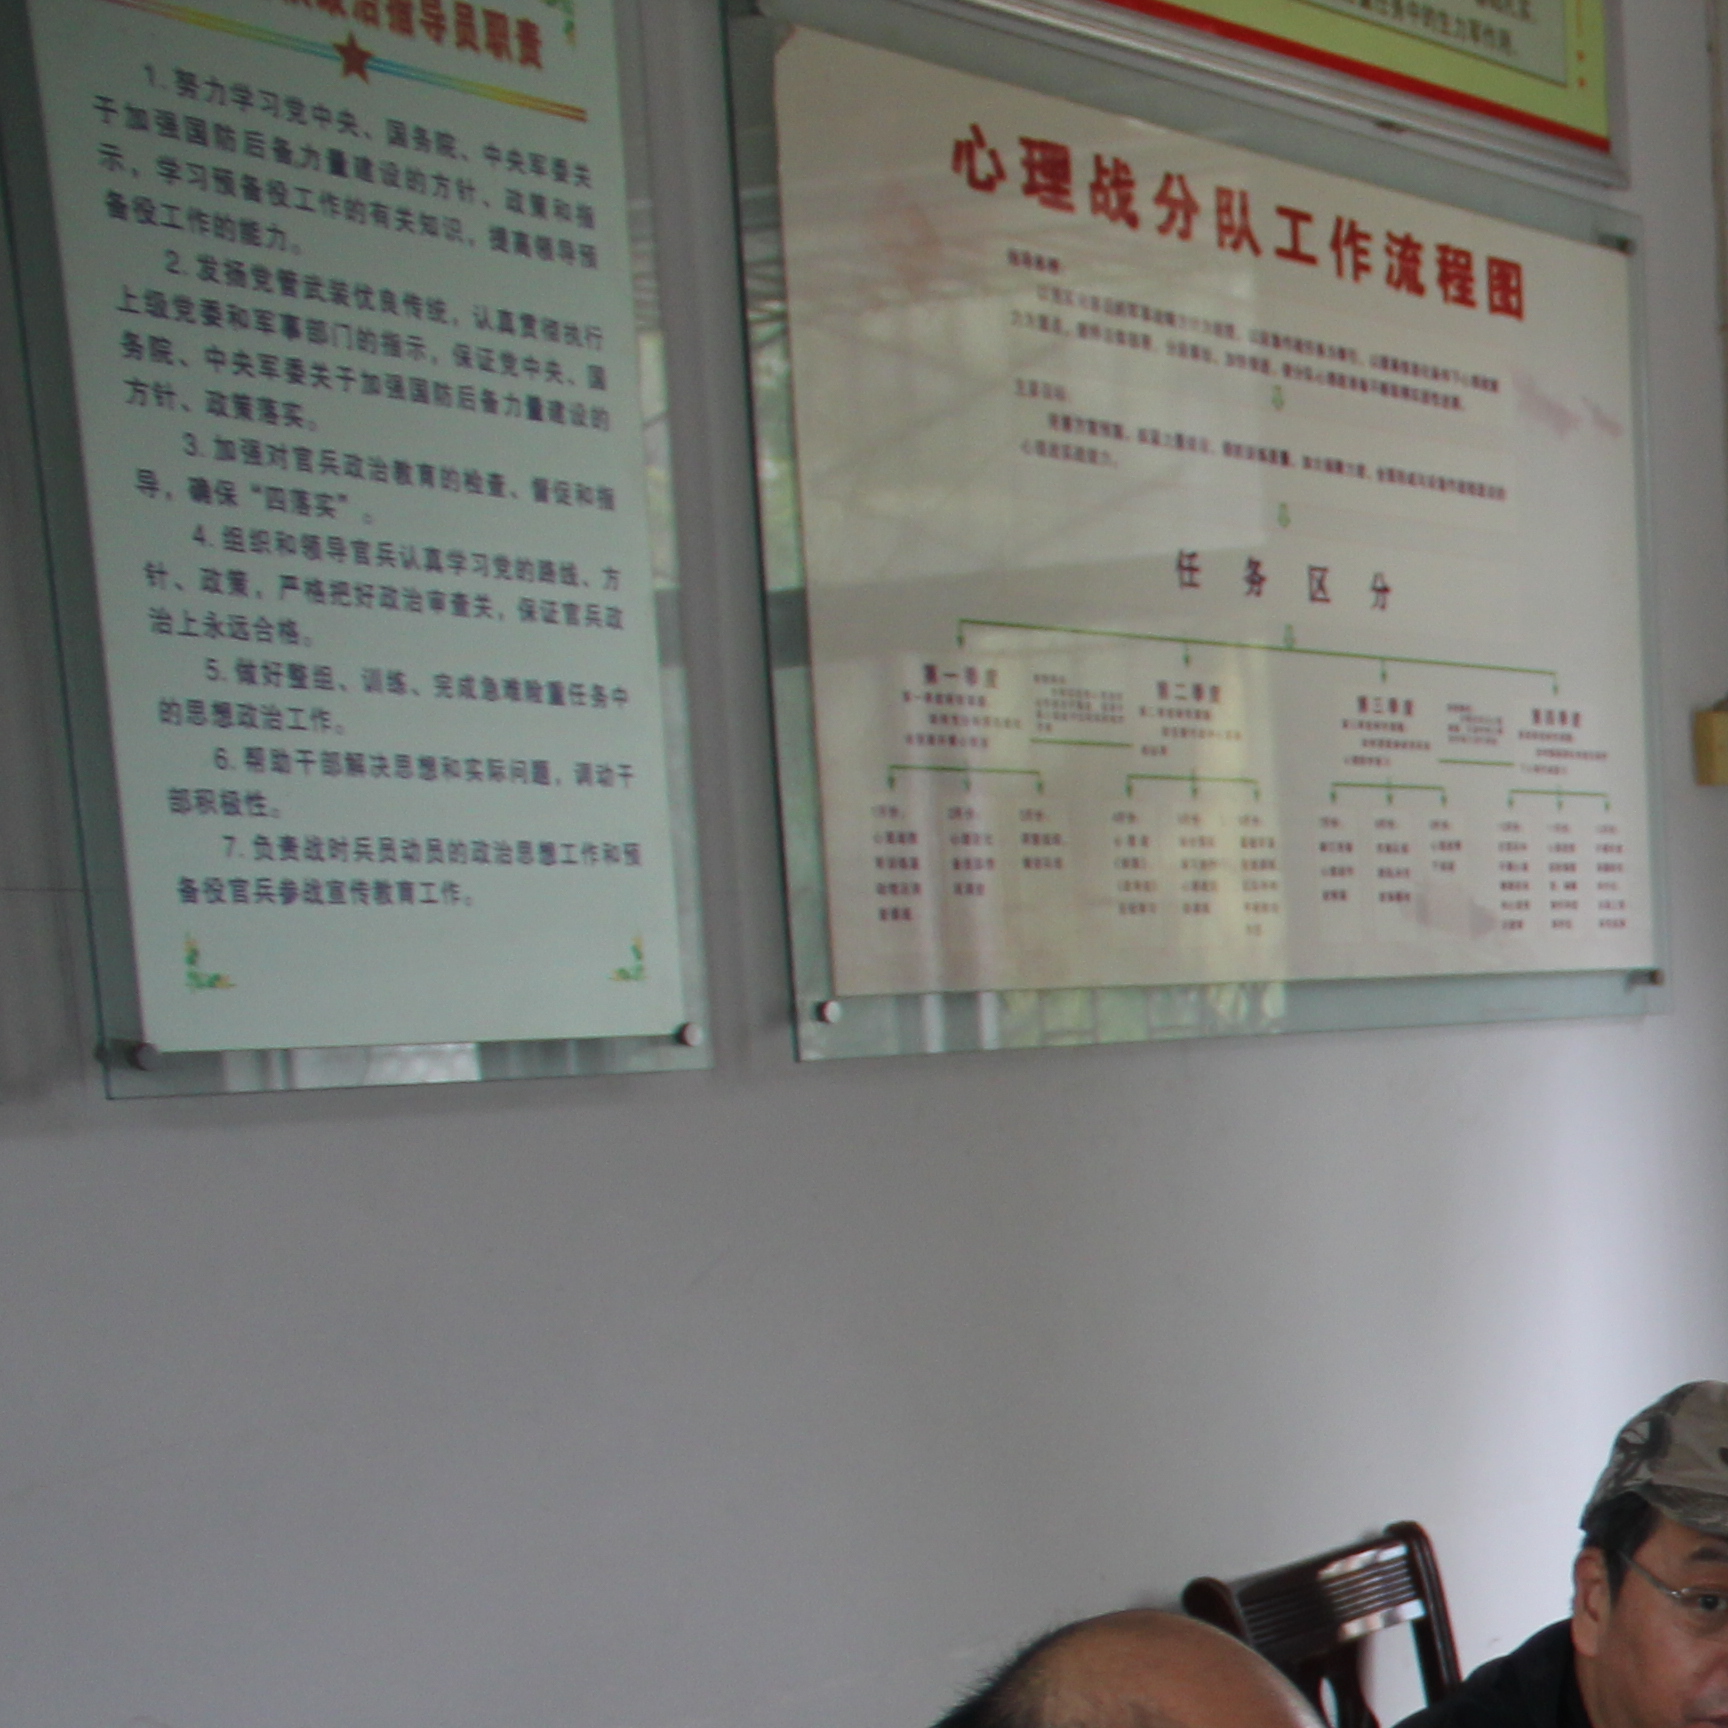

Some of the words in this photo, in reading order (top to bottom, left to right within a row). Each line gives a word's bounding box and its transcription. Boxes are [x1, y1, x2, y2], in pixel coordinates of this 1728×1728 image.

[952, 123, 1527, 322] 心理战分队工作流程图
[1176, 549, 1392, 611] 任务区分
